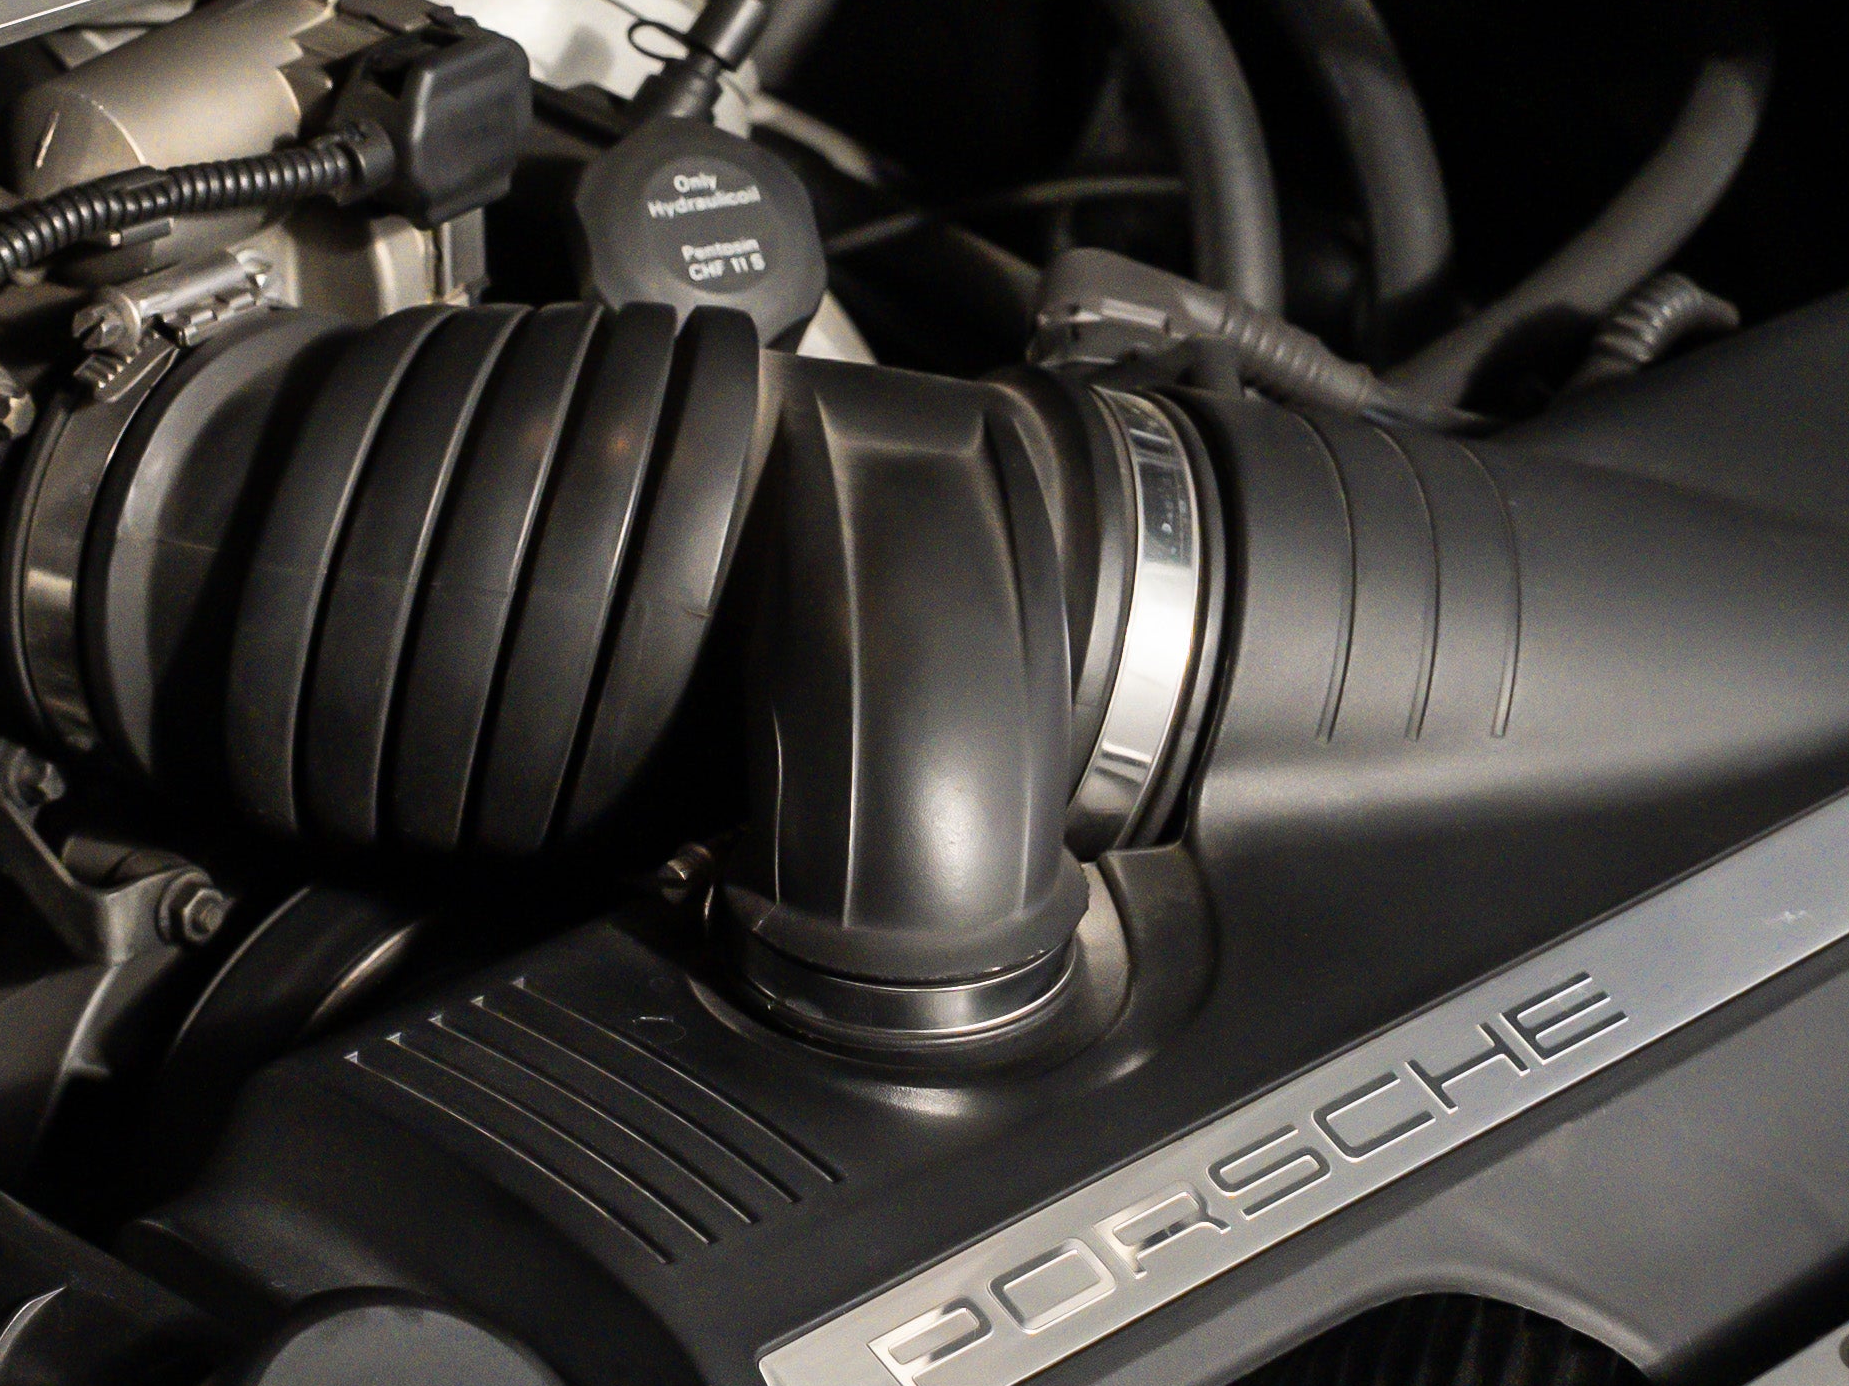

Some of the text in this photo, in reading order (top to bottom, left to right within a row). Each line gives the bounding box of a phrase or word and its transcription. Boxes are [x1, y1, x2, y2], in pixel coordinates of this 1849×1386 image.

[673, 172, 718, 194] Only
[681, 238, 761, 263] Pentosin
[688, 259, 726, 282] CHF
